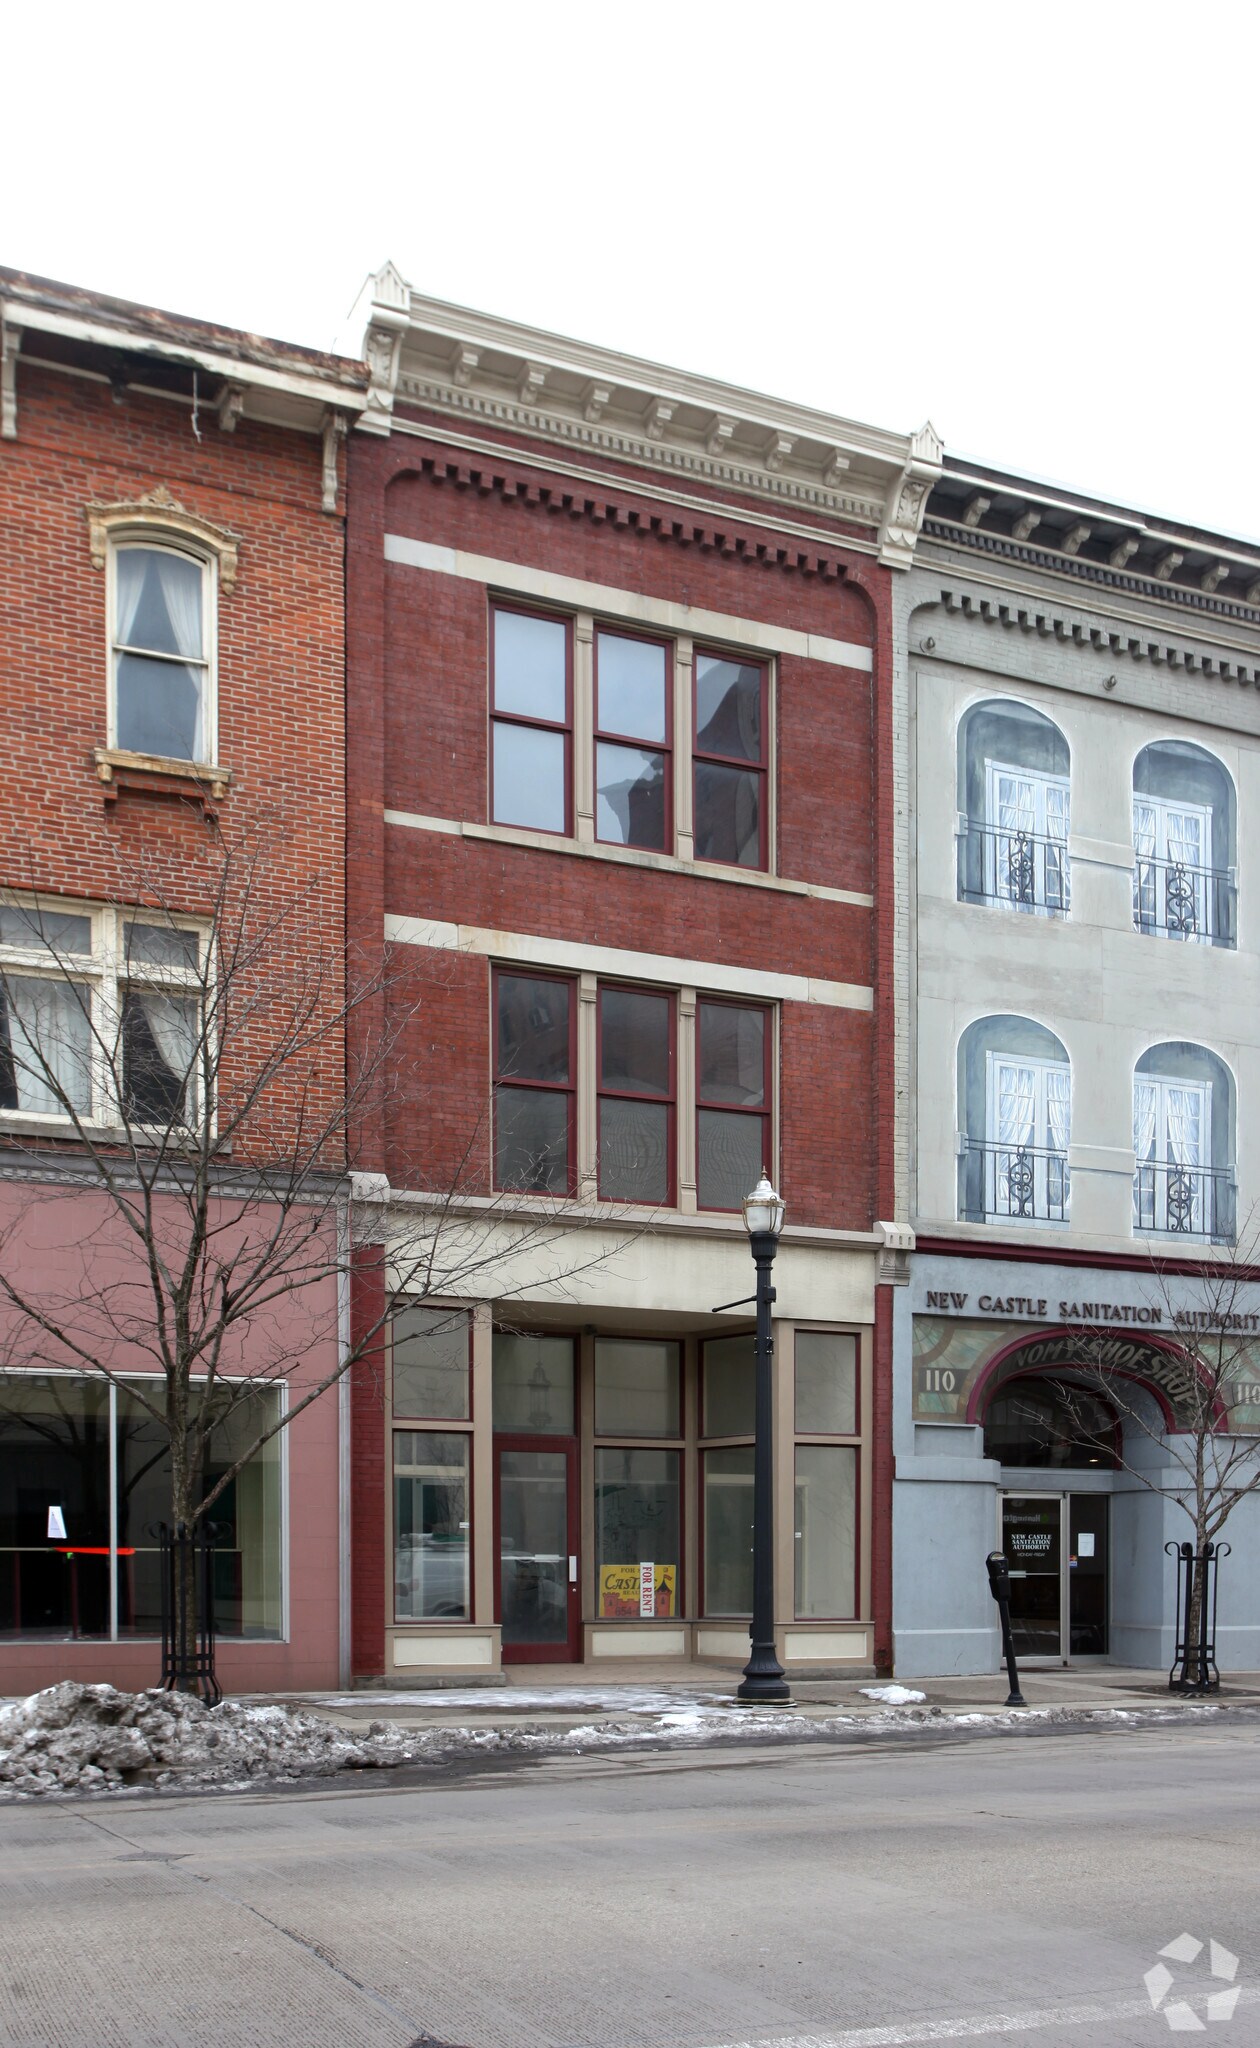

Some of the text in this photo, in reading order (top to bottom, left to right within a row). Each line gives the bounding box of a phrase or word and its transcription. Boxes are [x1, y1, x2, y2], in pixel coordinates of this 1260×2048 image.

[926, 1290, 968, 1309] NEW
[978, 1295, 1047, 1315] CASTLE
[1059, 1301, 1162, 1323] SANITATION
[1083, 1339, 1151, 1369] SHOE
[926, 1369, 956, 1392] 110
[642, 1567, 652, 1584] FOR
[642, 1587, 652, 1613] RENT
